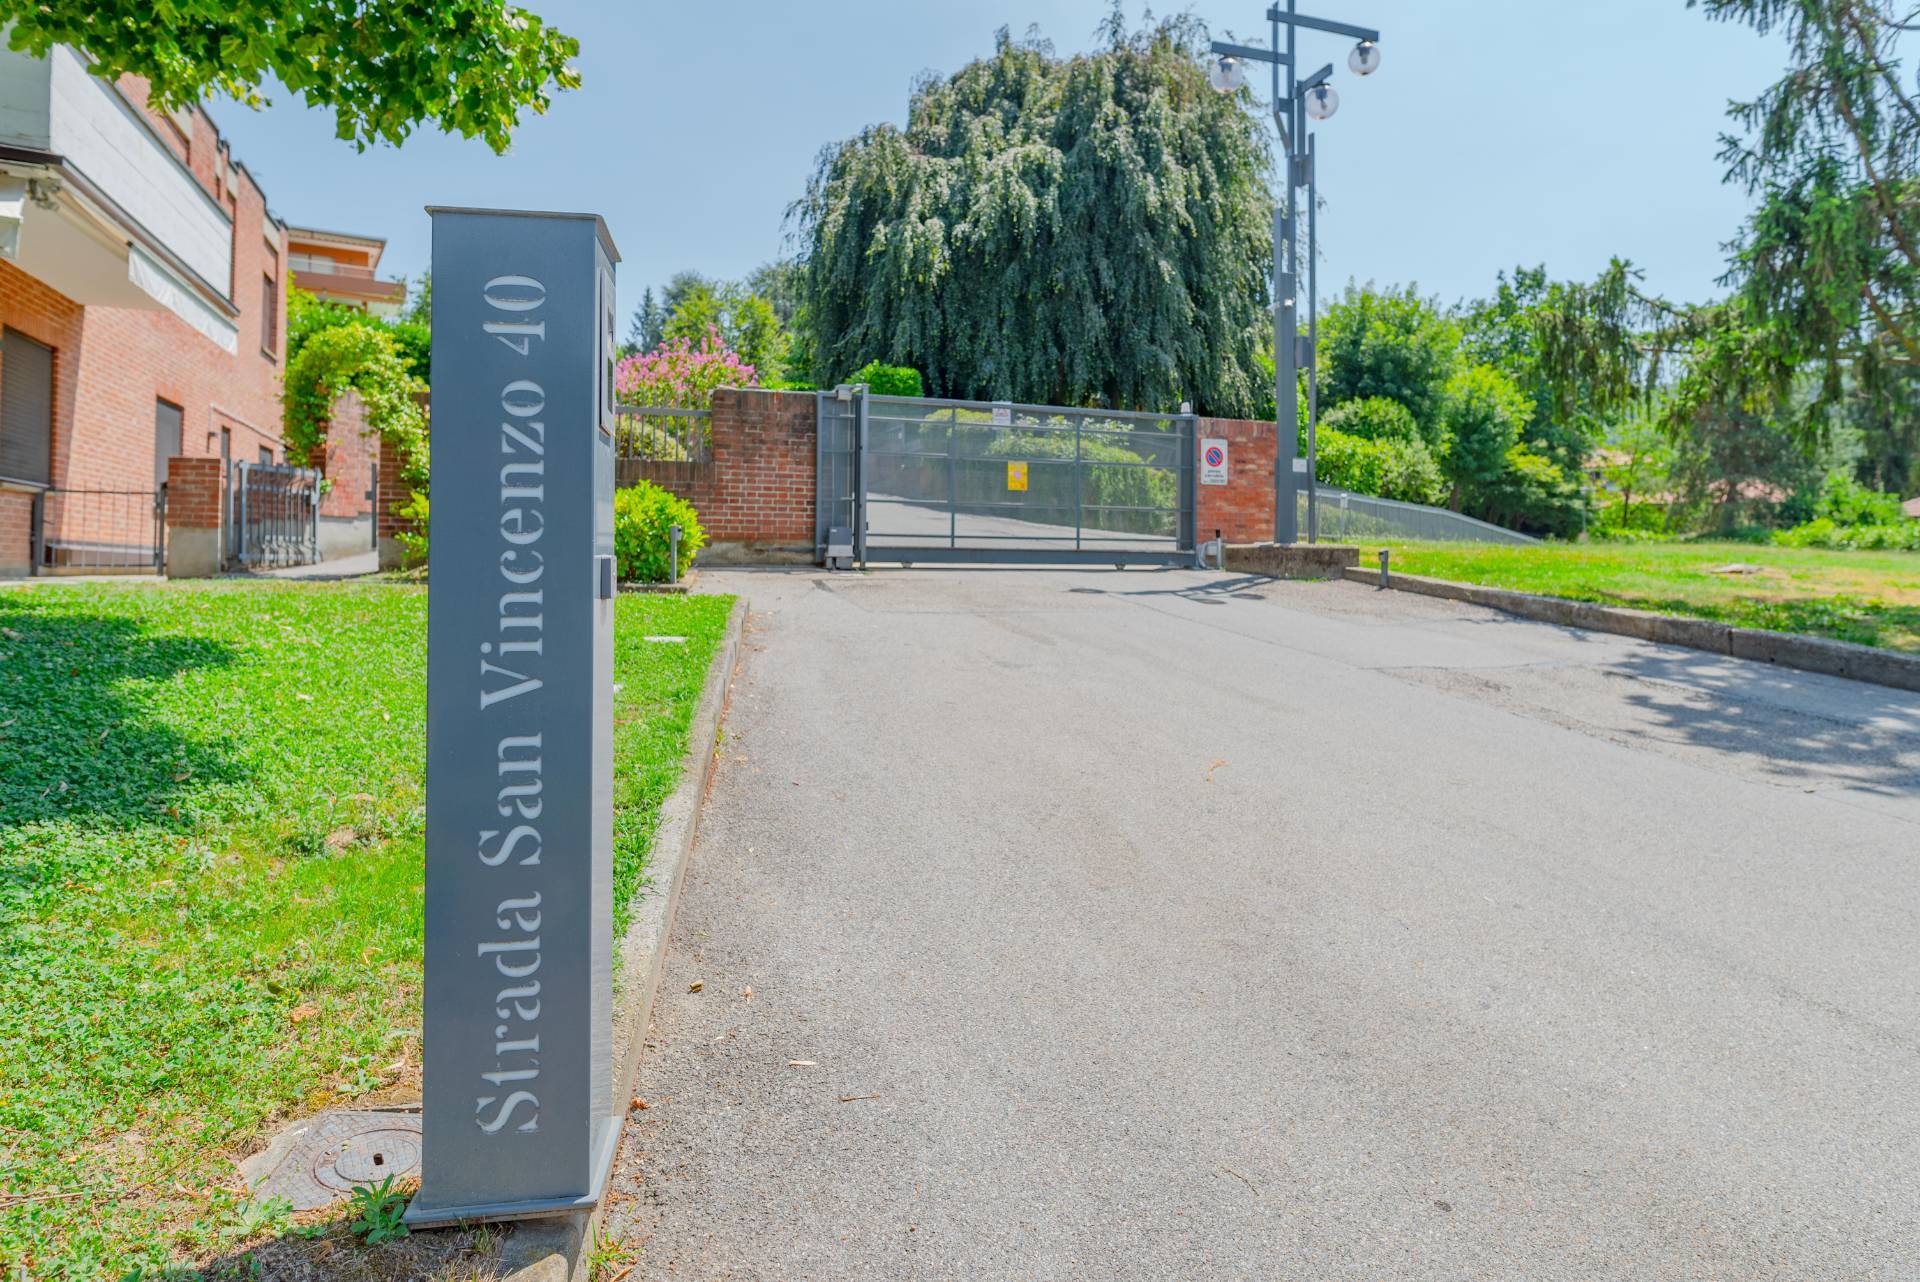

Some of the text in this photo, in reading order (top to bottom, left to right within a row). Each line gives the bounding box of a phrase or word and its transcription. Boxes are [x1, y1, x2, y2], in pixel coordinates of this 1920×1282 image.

[475, 274, 546, 1135] Strada San Vincenzo 40
